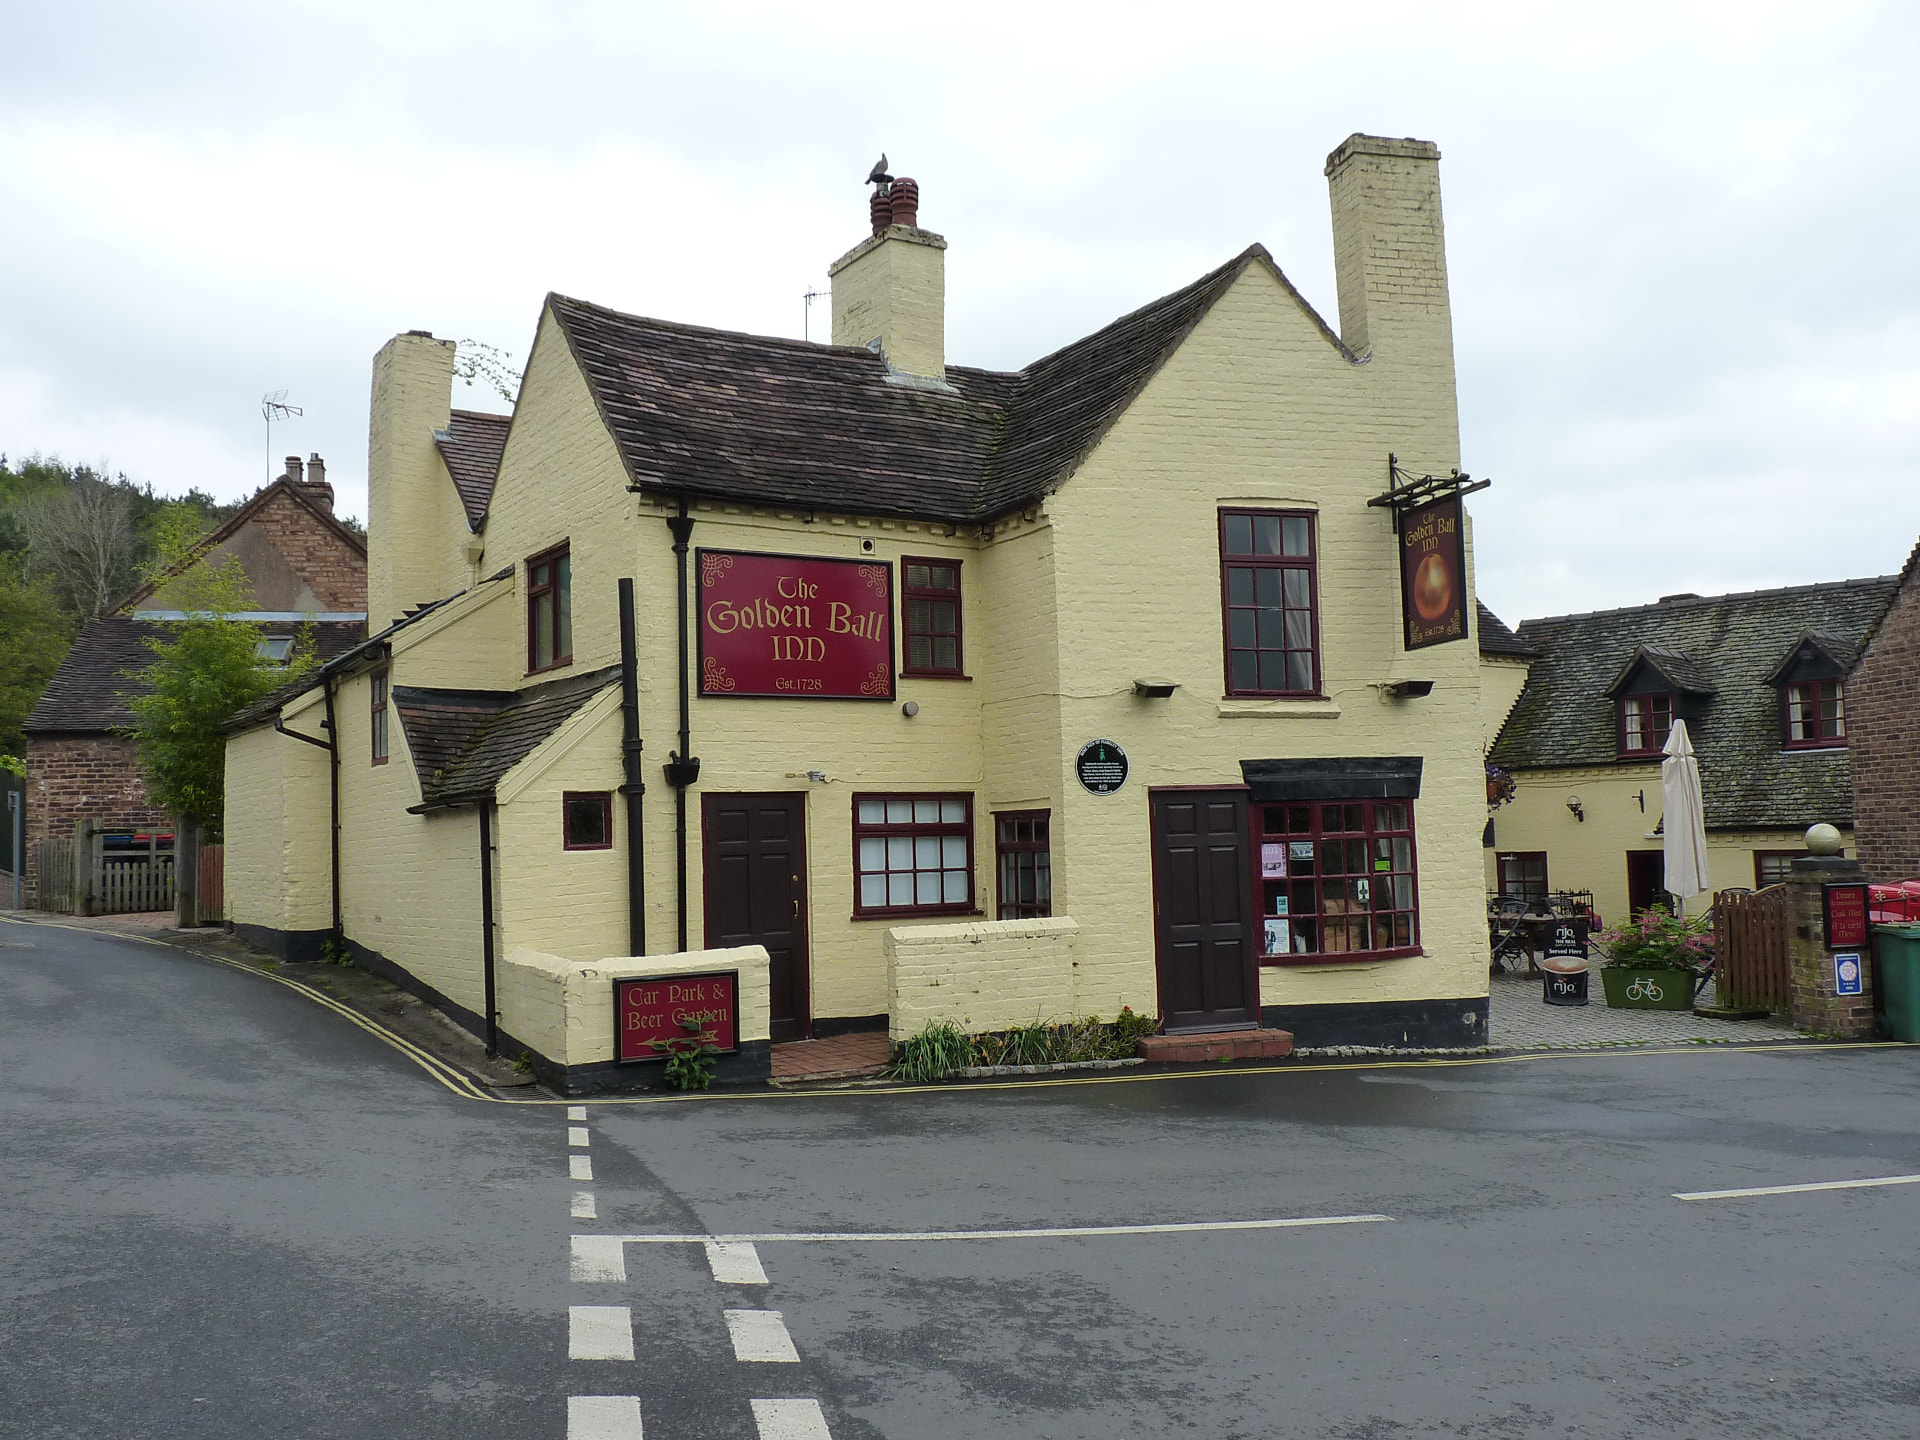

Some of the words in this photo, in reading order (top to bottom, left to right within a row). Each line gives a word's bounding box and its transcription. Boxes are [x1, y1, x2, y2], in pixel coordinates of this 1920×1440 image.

[1423, 512, 1435, 524] The
[1405, 524, 1434, 547] Golden
[1437, 518, 1456, 534] Ball
[776, 575, 819, 601] The
[706, 597, 812, 634] Golden
[825, 601, 886, 642] Ball
[770, 635, 826, 662] INN
[628, 987, 660, 1007] Car
[667, 984, 705, 1004] Park
[712, 983, 725, 1000] &
[626, 1011, 664, 1030] Beer
[671, 1006, 728, 1027] Garden
